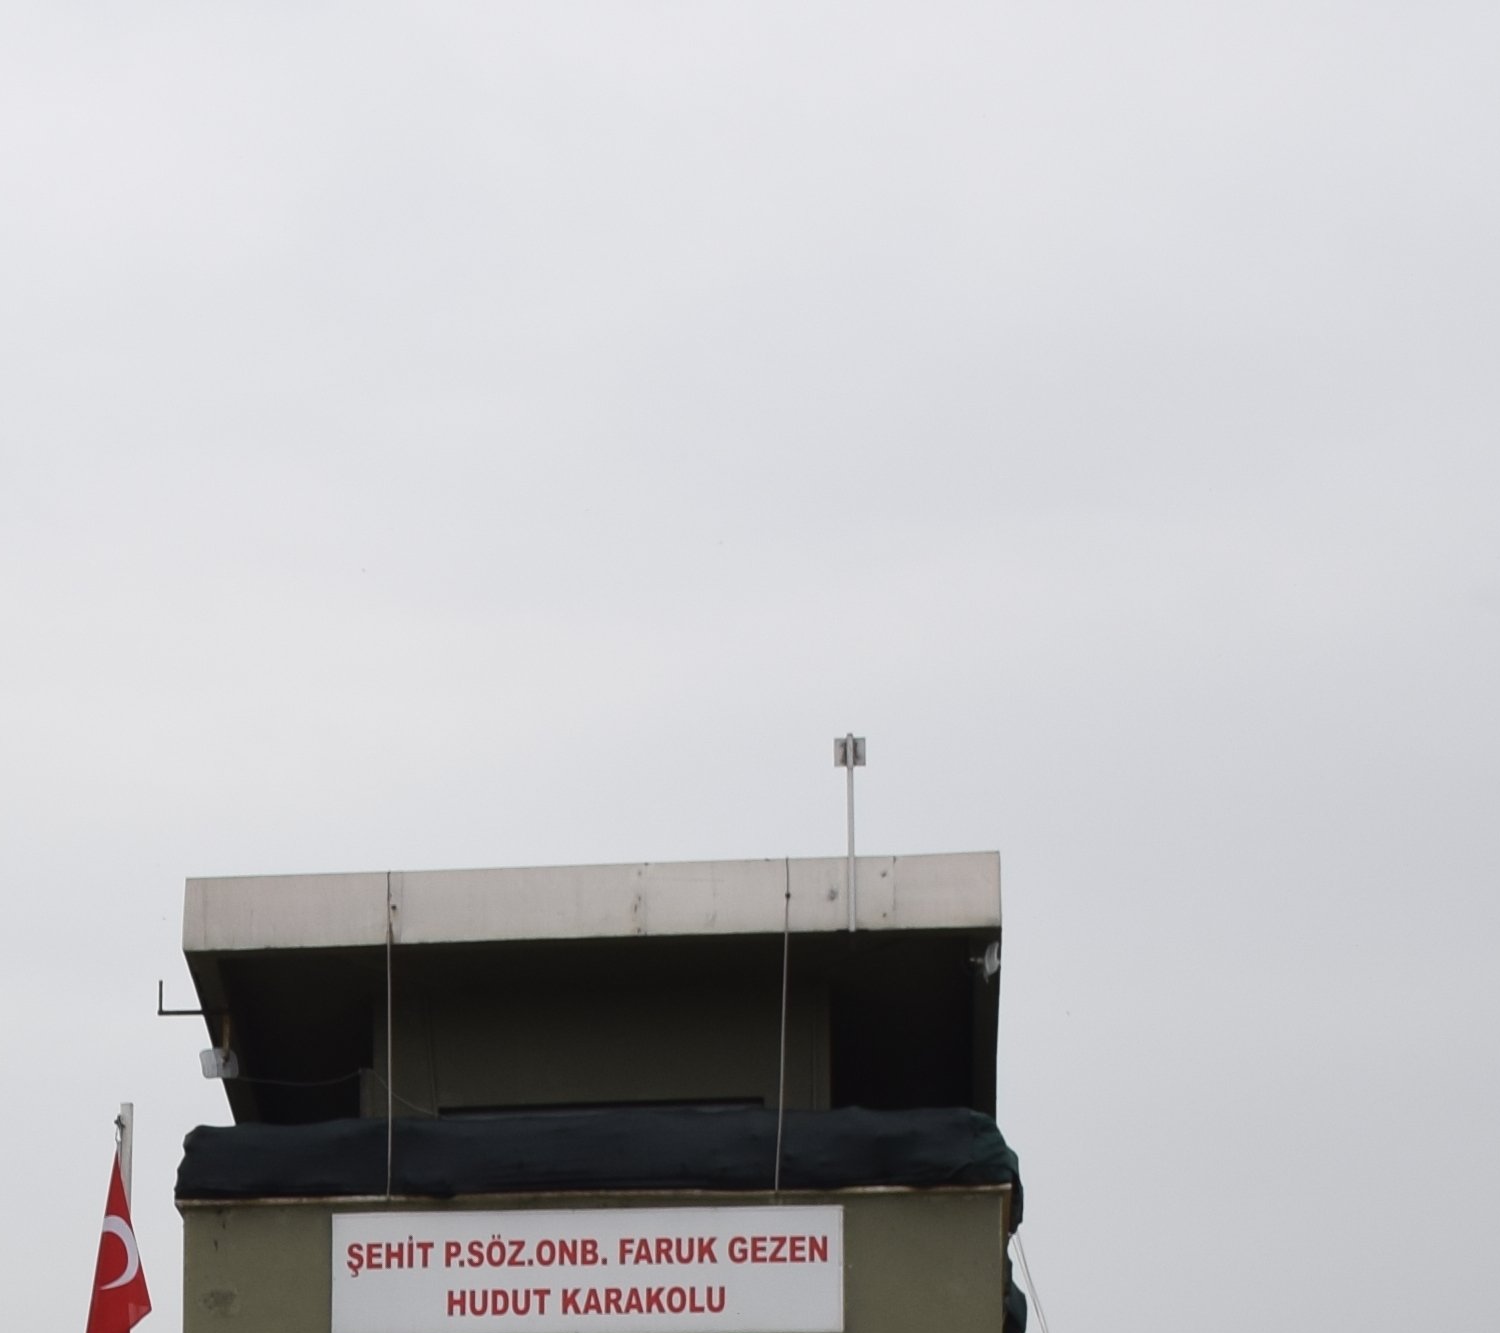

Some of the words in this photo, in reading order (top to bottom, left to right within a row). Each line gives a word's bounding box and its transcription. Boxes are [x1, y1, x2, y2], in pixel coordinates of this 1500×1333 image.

[347, 1235, 434, 1278] ŞEHİT
[445, 1233, 608, 1269] P.SÖZ.ONB.
[618, 1236, 718, 1266] FARUK
[728, 1235, 829, 1264] GEZEN
[447, 1288, 551, 1317] HUDUT
[561, 1285, 726, 1315] KARAKOLU
